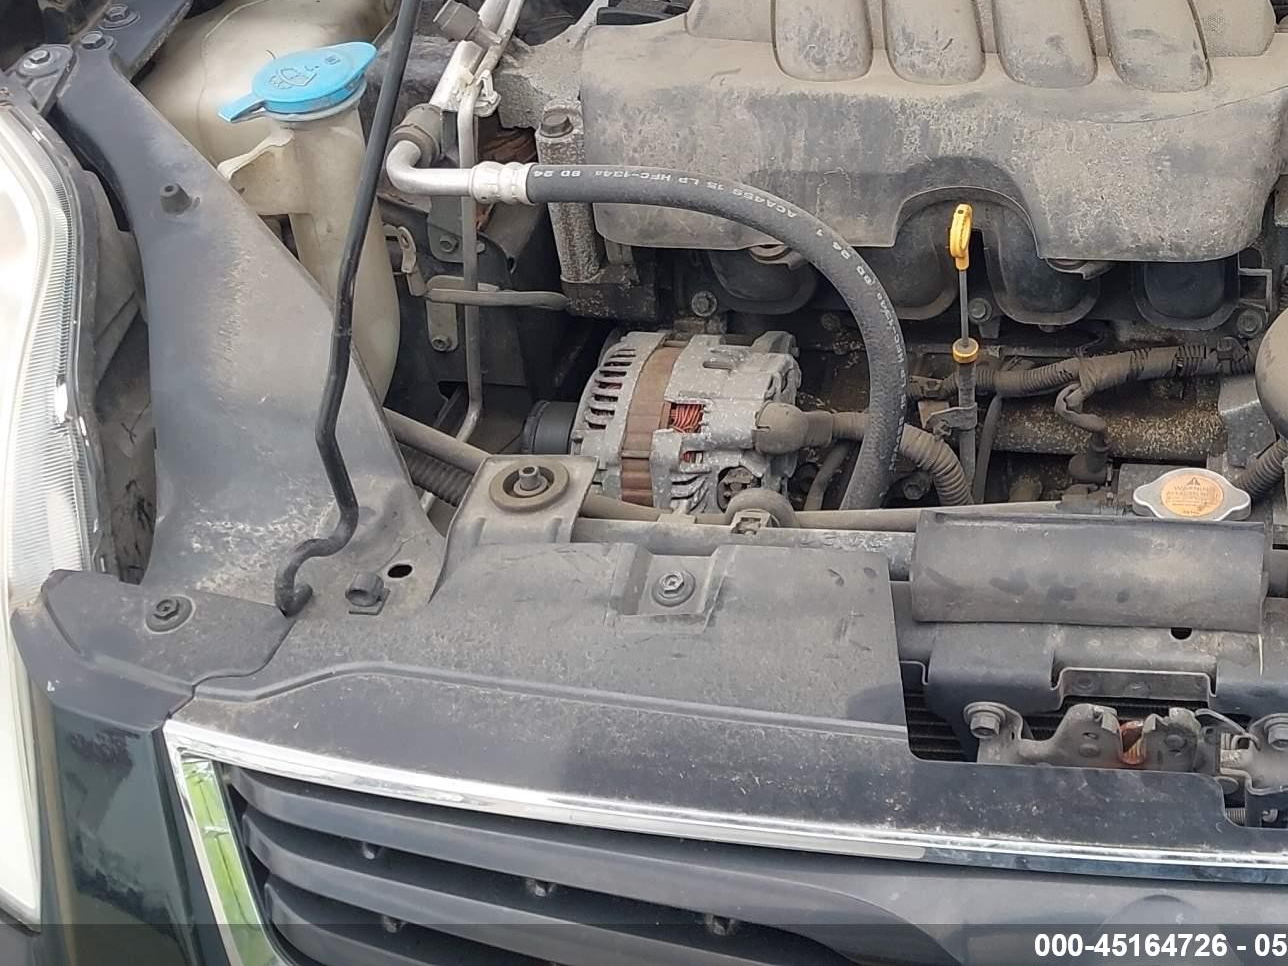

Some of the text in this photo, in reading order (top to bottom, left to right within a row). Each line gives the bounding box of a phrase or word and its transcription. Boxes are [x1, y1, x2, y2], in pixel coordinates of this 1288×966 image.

[532, 169, 554, 178] 24
[678, 176, 700, 186] LP
[705, 180, 724, 191] 15
[732, 187, 797, 218] ACA459
